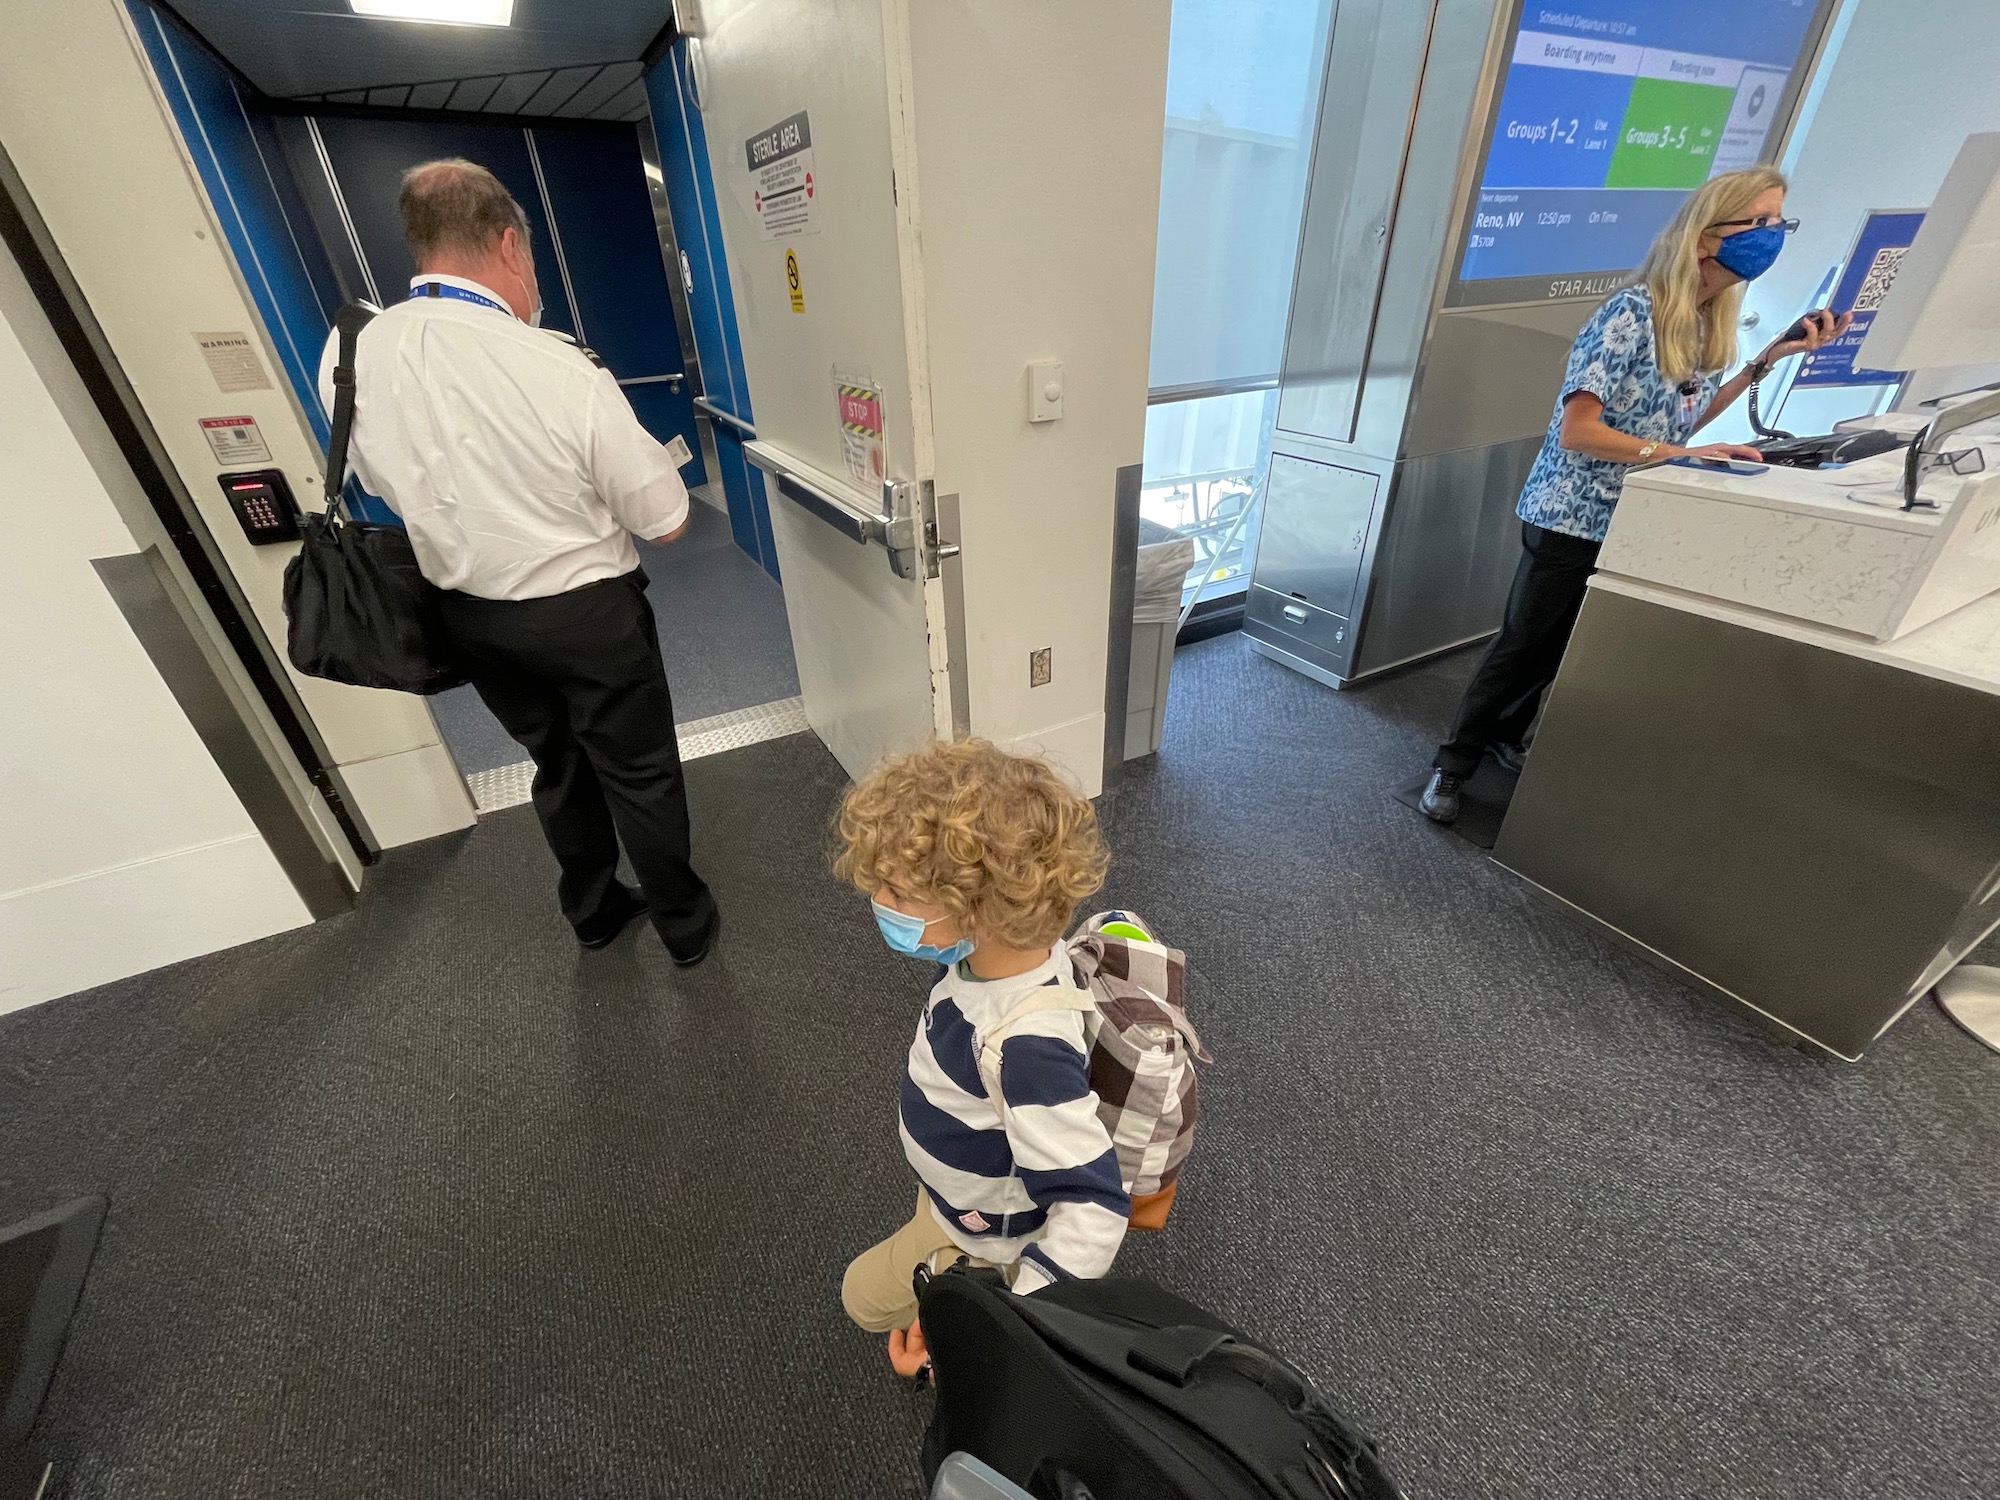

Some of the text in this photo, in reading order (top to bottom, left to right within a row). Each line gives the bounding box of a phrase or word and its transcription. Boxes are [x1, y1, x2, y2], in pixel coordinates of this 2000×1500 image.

[1544, 43, 1616, 66] Boarding anytime
[1669, 59, 1702, 79] Boarding
[1507, 117, 1579, 144] Groups 1-2
[1594, 119, 1608, 131] Use
[752, 122, 802, 163] STERILE AREA
[1584, 138, 1601, 150] Lane
[1626, 125, 1689, 149] Groups 3-5
[1475, 211, 1524, 229] Reno, NV
[1537, 212, 1572, 228] 12:50 pm
[1588, 211, 1618, 223] On Time
[1478, 236, 1495, 248] 5708
[1548, 280, 1582, 298] STAR
[200, 338, 250, 350] WARNING
[1844, 335, 1863, 346] loca
[847, 401, 868, 421] STOP
[209, 418, 244, 428] NOTICE
